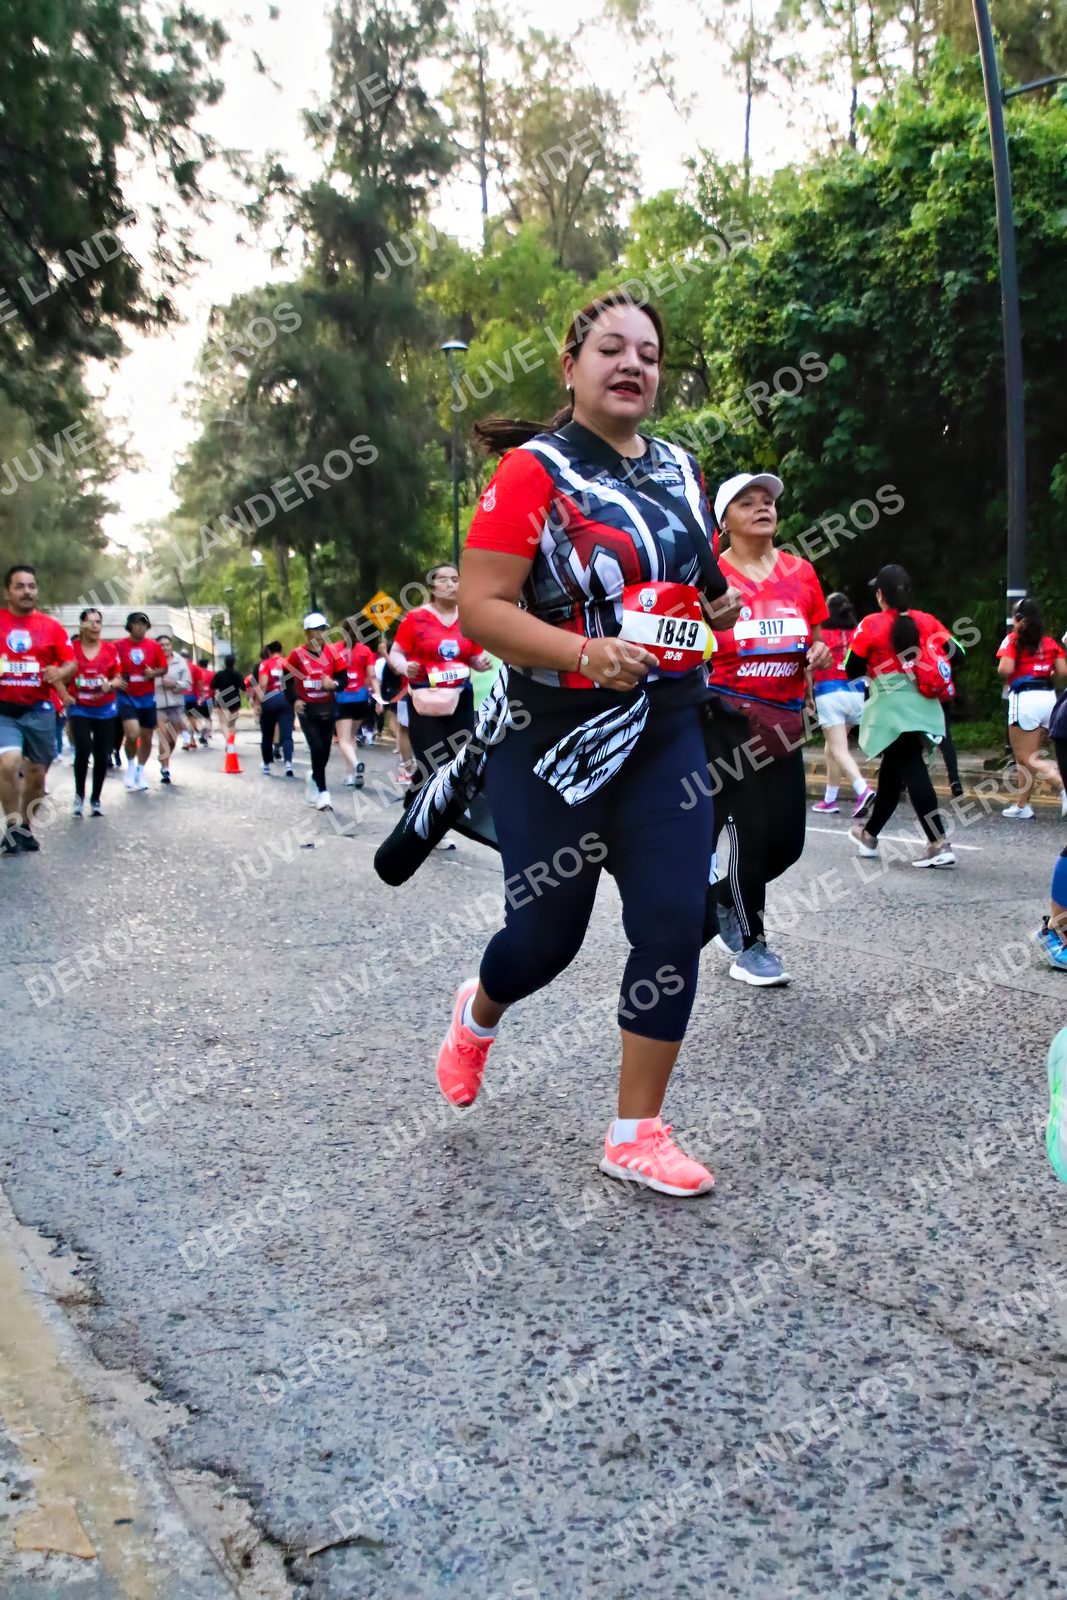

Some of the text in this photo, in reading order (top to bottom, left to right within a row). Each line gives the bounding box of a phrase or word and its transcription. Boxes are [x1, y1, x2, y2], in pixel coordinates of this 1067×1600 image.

[655, 618, 699, 647] 1849
[759, 620, 784, 635] 3117
[737, 662, 799, 678] SANTIAGO
